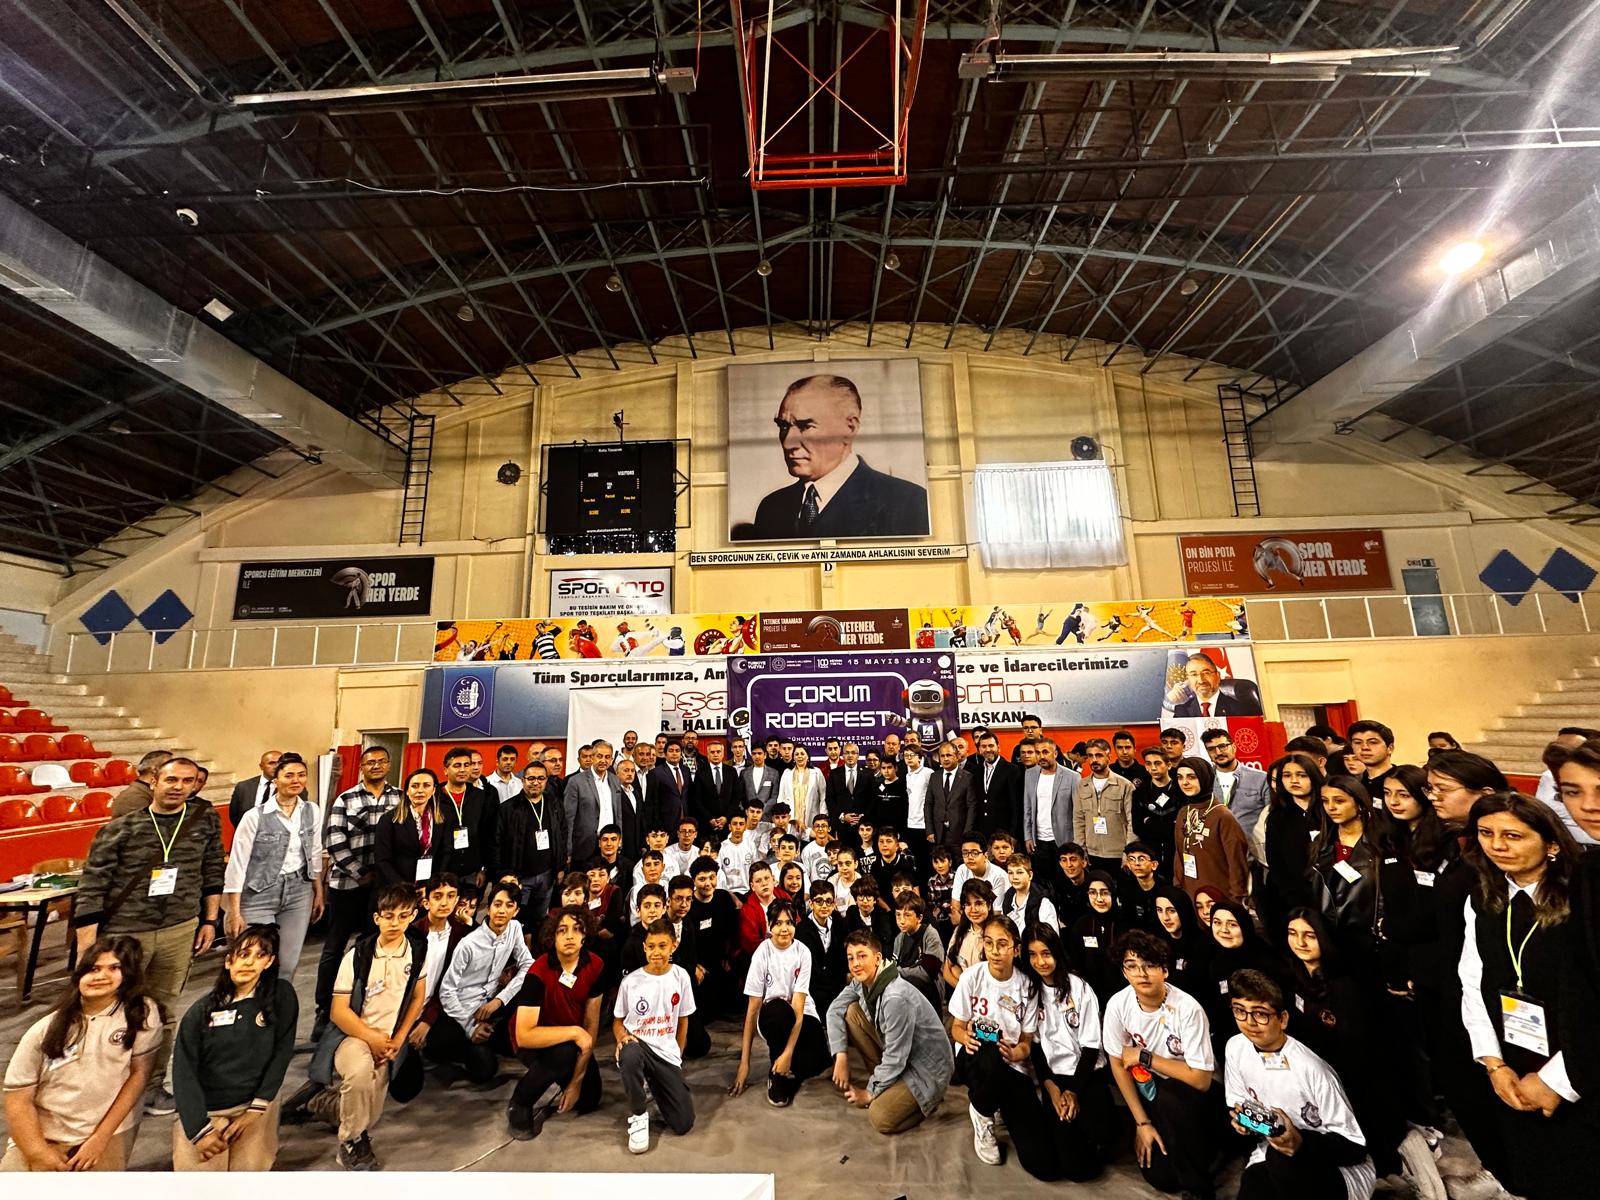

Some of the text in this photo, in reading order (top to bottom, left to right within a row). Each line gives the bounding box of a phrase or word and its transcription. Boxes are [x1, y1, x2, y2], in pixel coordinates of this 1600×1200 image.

[691, 555, 706, 563] BEN
[708, 554, 754, 562] SPORCUNUN
[811, 551, 828, 560] AYNI
[830, 550, 866, 559] ZAMANDA
[868, 549, 915, 558] AHLAKLISINI
[1186, 545, 1236, 559] ON BİN POTA
[1299, 541, 1334, 559] SPOR
[244, 567, 323, 579] SPORCU EĞİTİM MERKEZLERİ
[824, 562, 832, 571] D
[1188, 559, 1234, 573] PROJESİ İLE
[1329, 559, 1368, 576] YERDE
[368, 572, 397, 587] SPOR
[366, 587, 420, 603] HER YERDE
[558, 581, 665, 595] SPOR OTO
[840, 621, 875, 633] YETENEK
[840, 632, 884, 645] HER YERDE
[980, 663, 999, 673] ve
[1004, 658, 1129, 673] İdarecilerimize
[533, 671, 565, 684] Tüm
[570, 669, 699, 686] Sporcularımıza,
[784, 684, 871, 708] ÇORUM
[765, 710, 891, 729] ROBOFEST
[970, 996, 989, 1016] 23
